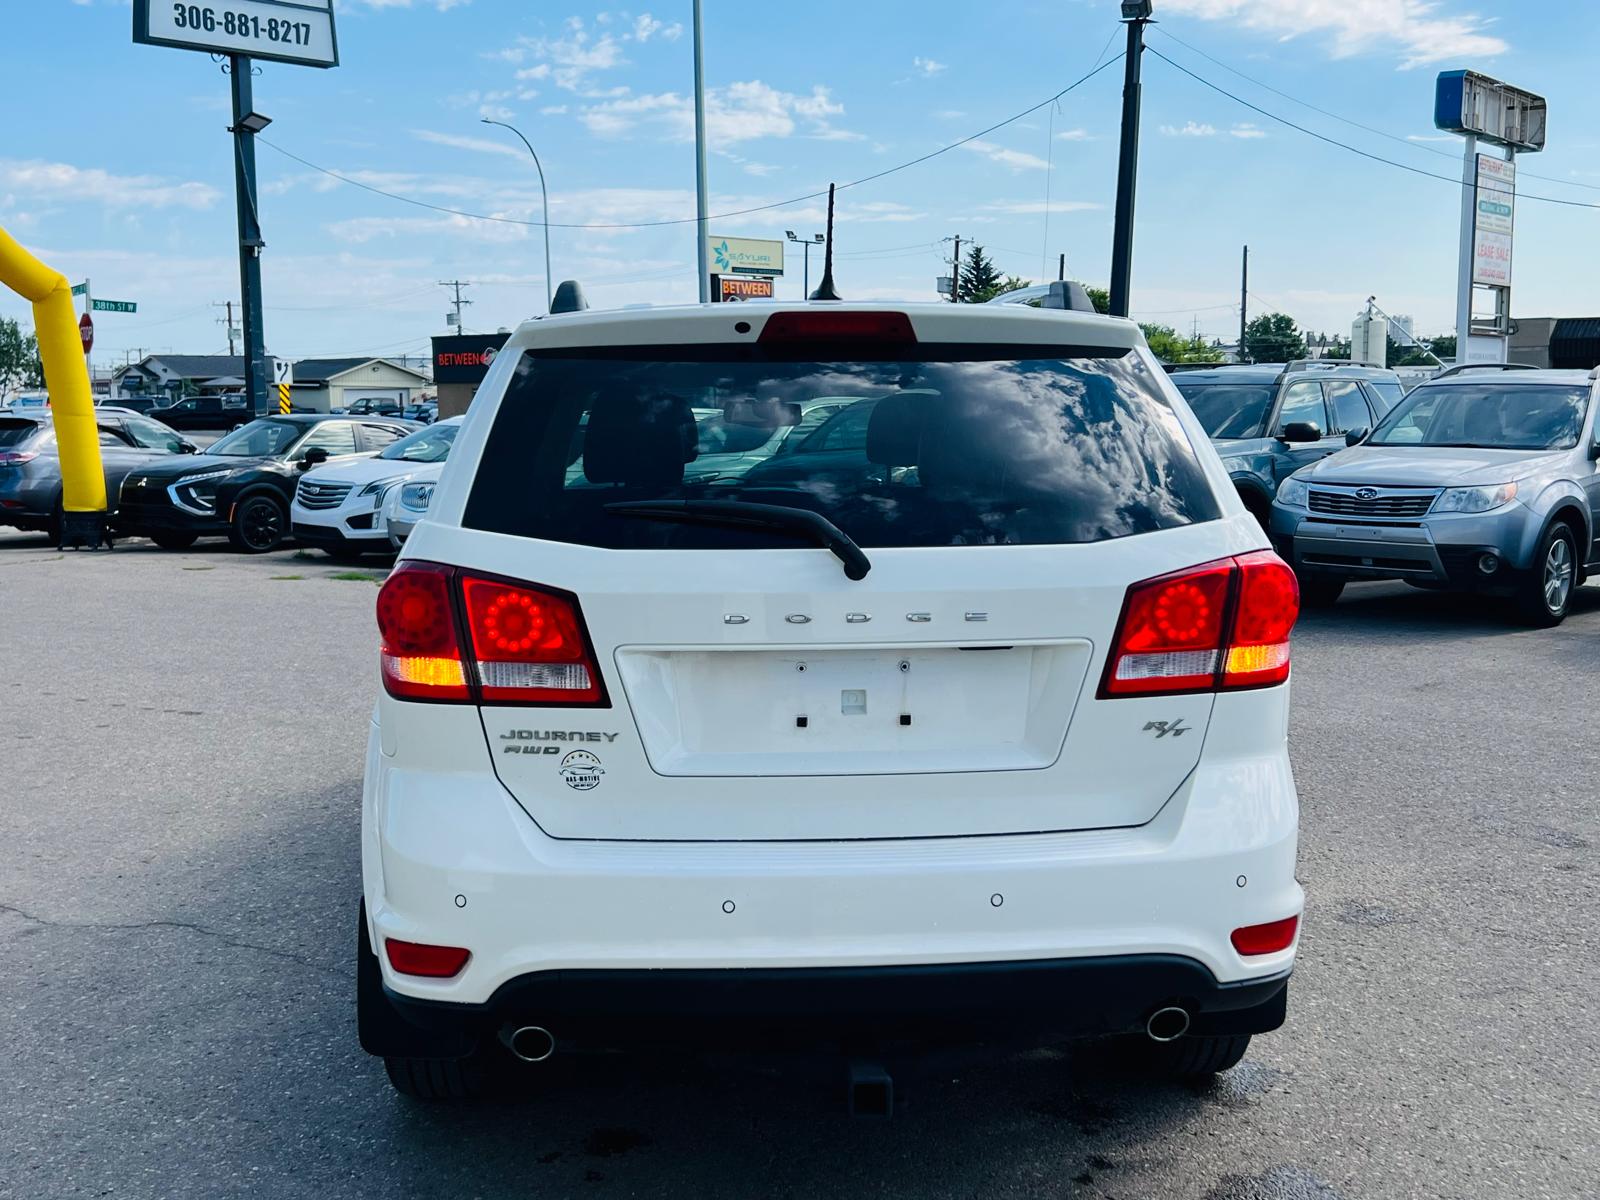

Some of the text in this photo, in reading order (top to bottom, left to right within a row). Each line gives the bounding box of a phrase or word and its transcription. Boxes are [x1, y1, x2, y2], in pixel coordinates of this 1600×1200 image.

[173, 3, 311, 46] 306-881-8217
[1477, 243, 1509, 261] LEASE SALE
[723, 281, 771, 295] BETWEEN
[95, 301, 115, 310] 38th
[127, 304, 134, 312] W
[80, 326, 93, 341] STOP
[438, 353, 480, 366] BETWEEN
[724, 612, 988, 624] DODGE
[1142, 719, 1192, 738] R/T
[500, 730, 619, 742] JOURNEY
[504, 745, 560, 755] AWD
